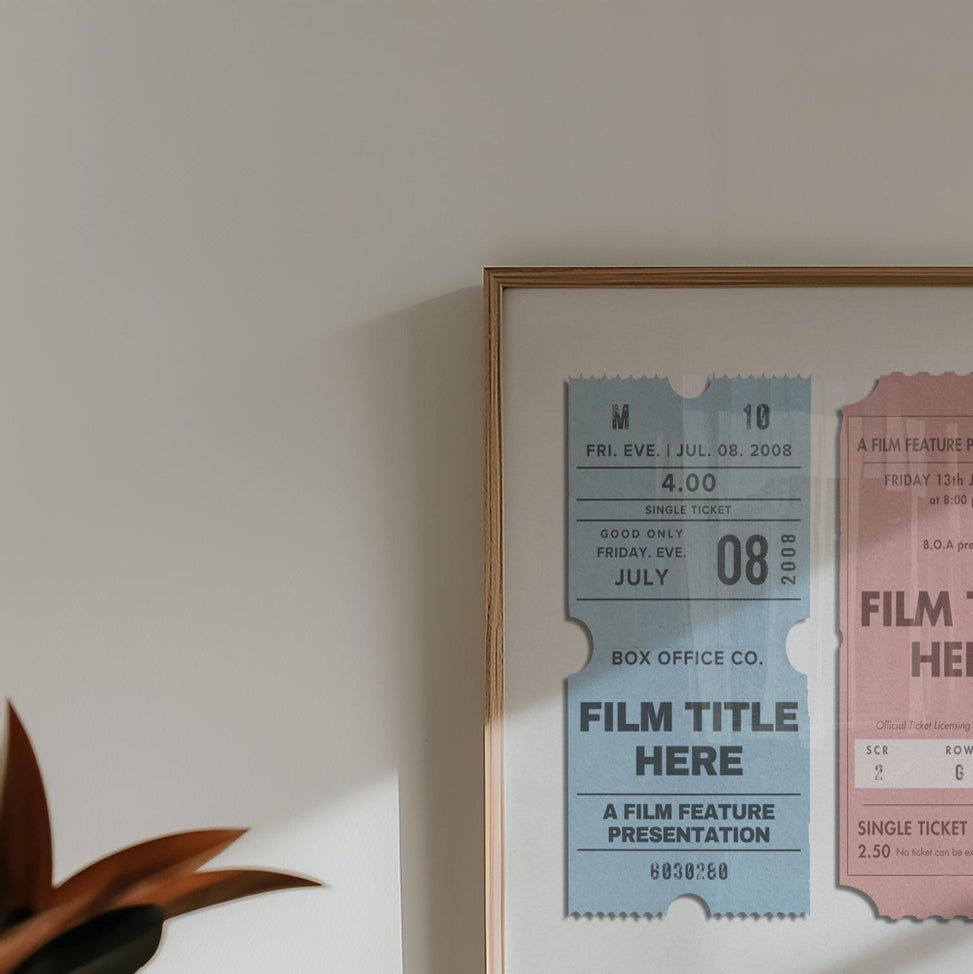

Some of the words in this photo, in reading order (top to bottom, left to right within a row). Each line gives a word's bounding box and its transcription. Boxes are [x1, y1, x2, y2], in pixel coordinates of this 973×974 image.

[611, 404, 629, 430] M
[743, 403, 770, 430] 10
[586, 444, 617, 457] FRI.
[624, 444, 660, 457] EVE.
[676, 444, 711, 457] JUL.
[718, 444, 743, 457] 08.
[750, 444, 792, 457] 2008
[857, 439, 868, 452] A
[872, 439, 902, 452] FILM
[905, 439, 962, 452] FEATURE
[662, 473, 716, 492] 4.00
[884, 474, 930, 486] FRIDAY
[937, 474, 963, 486] 13th
[929, 496, 940, 506] at
[944, 495, 967, 506] 8:00
[645, 505, 687, 514] SINGLE
[691, 505, 732, 514] TICKET
[600, 529, 640, 539] GOOD
[647, 529, 683, 539] ONLY
[923, 540, 953, 550] B.O.A
[597, 547, 652, 558] FRIDAY.
[657, 547, 687, 558] EVE.
[781, 534, 796, 585] 2008
[717, 534, 768, 586] 08
[615, 569, 669, 586] JULY
[861, 591, 953, 627] FILM
[612, 651, 650, 665] BOX
[657, 651, 724, 665] OFFICE
[731, 651, 763, 665] CO.
[580, 702, 673, 732] FILM
[685, 702, 798, 732] TITLE
[876, 720, 906, 730] Official
[909, 720, 932, 730] Ticket
[934, 720, 971, 732] Licensing
[866, 746, 888, 755] SCR
[945, 746, 973, 755] ROW
[635, 746, 743, 776] HERE
[874, 764, 883, 781] 2
[602, 804, 618, 820] A
[624, 804, 672, 820] FILM
[678, 804, 775, 820] FEATURE
[608, 827, 769, 843] PRESENTATION
[858, 821, 911, 836] SINGLE
[918, 821, 968, 836] TICKET
[858, 844, 890, 858] 2.50
[896, 848, 910, 857] No
[912, 848, 932, 857] ticket
[934, 849, 949, 857] can
[952, 848, 962, 857] be
